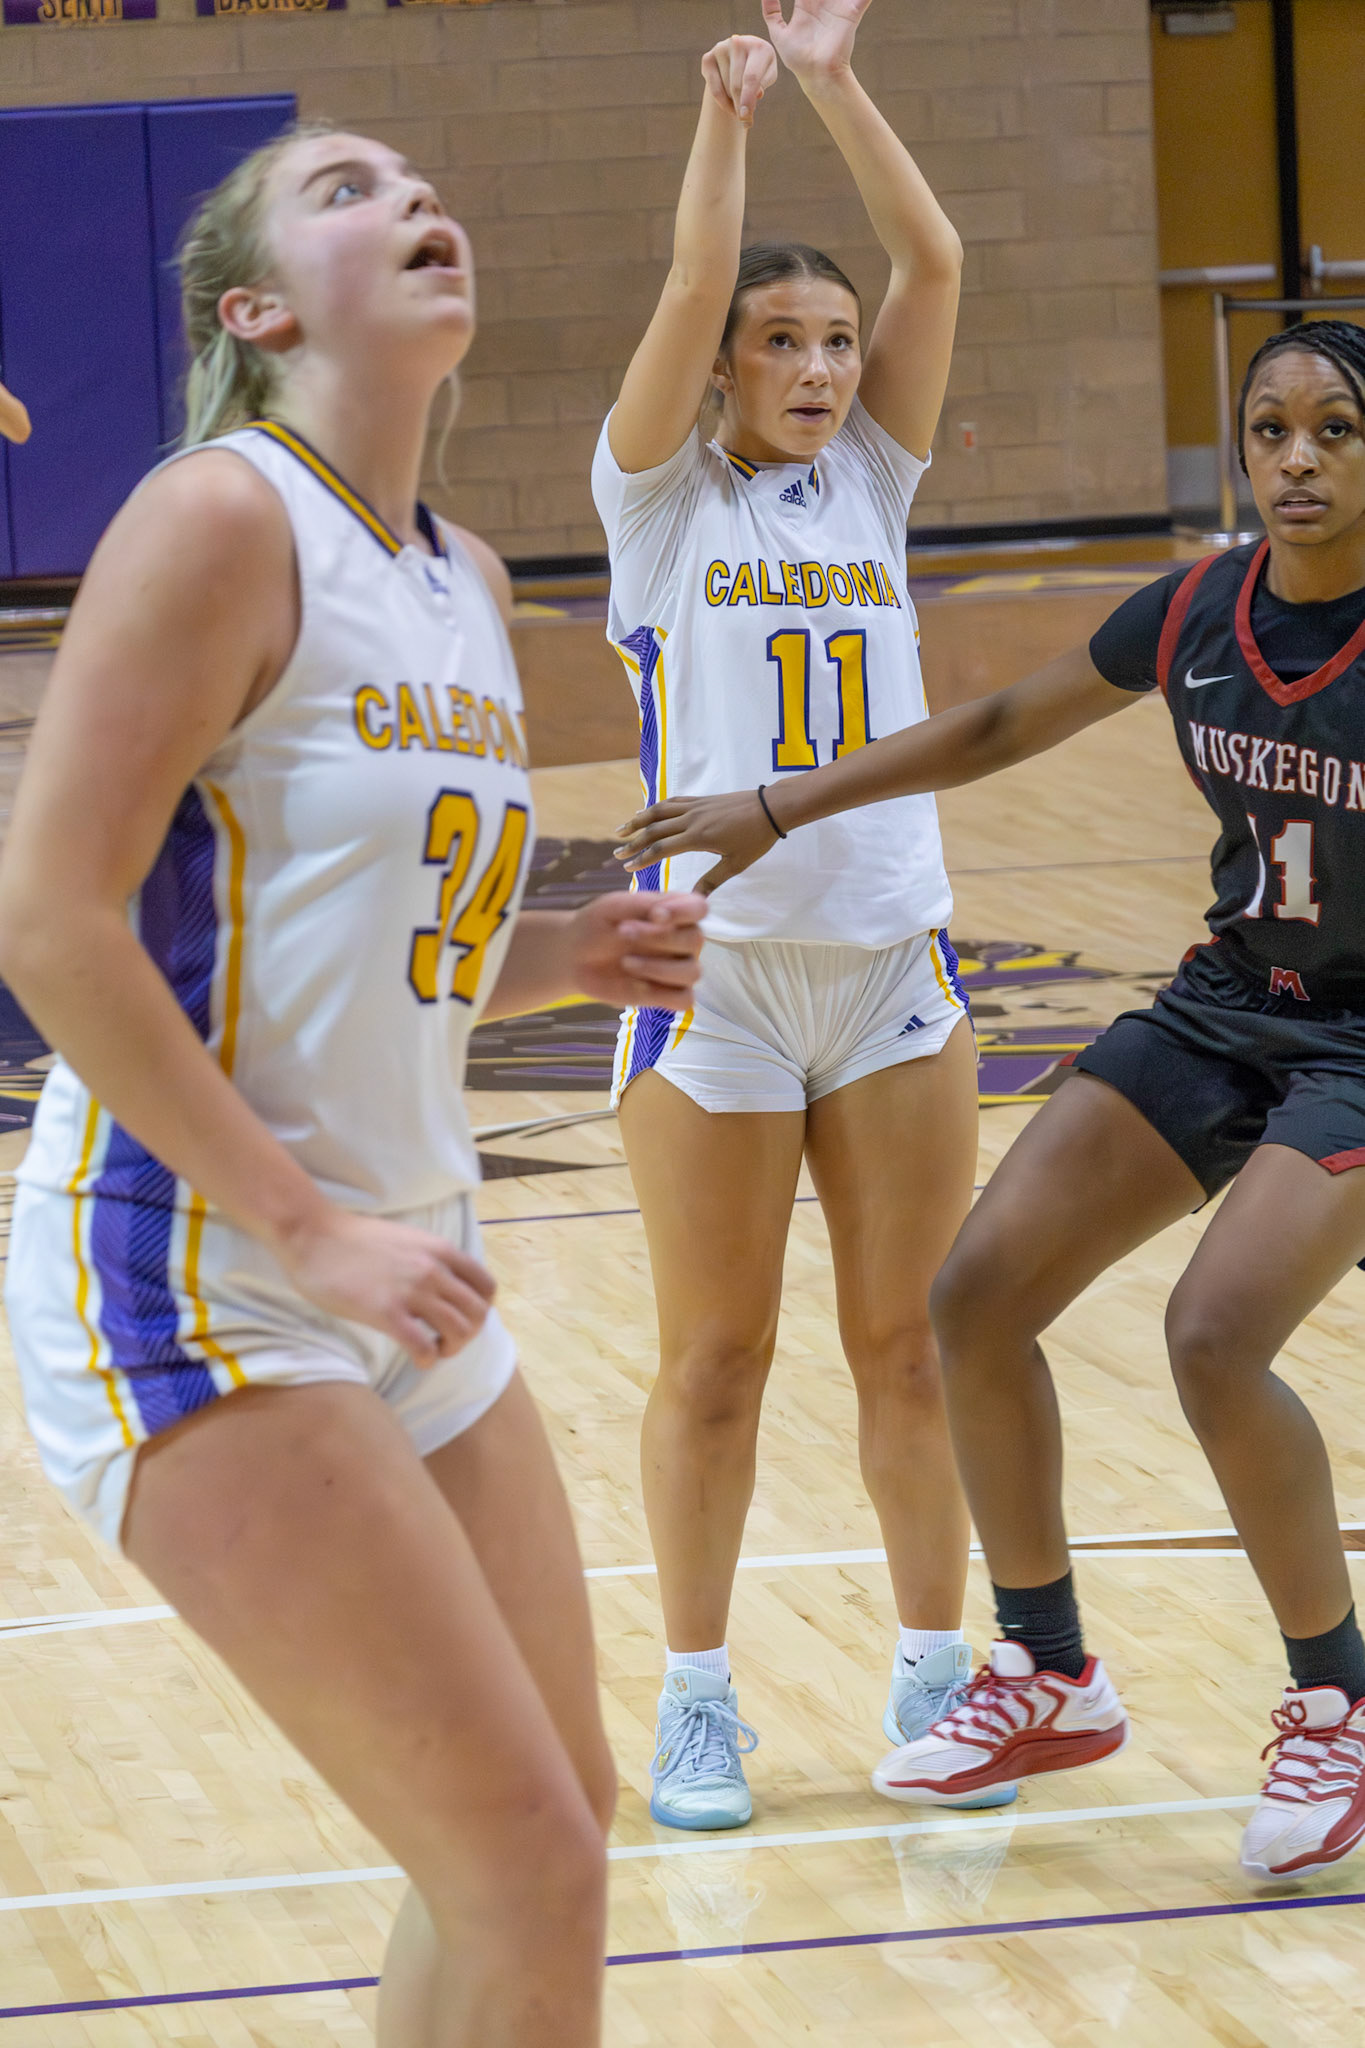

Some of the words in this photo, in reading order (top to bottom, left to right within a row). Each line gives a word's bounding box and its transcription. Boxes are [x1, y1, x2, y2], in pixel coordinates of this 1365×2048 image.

[705, 558, 902, 609] CALEDONIA
[354, 682, 529, 771] CALEDON
[766, 628, 877, 772] 11
[1188, 720, 1365, 812] MUSKEGON
[407, 786, 529, 1006] 34
[1268, 966, 1311, 1002] M
